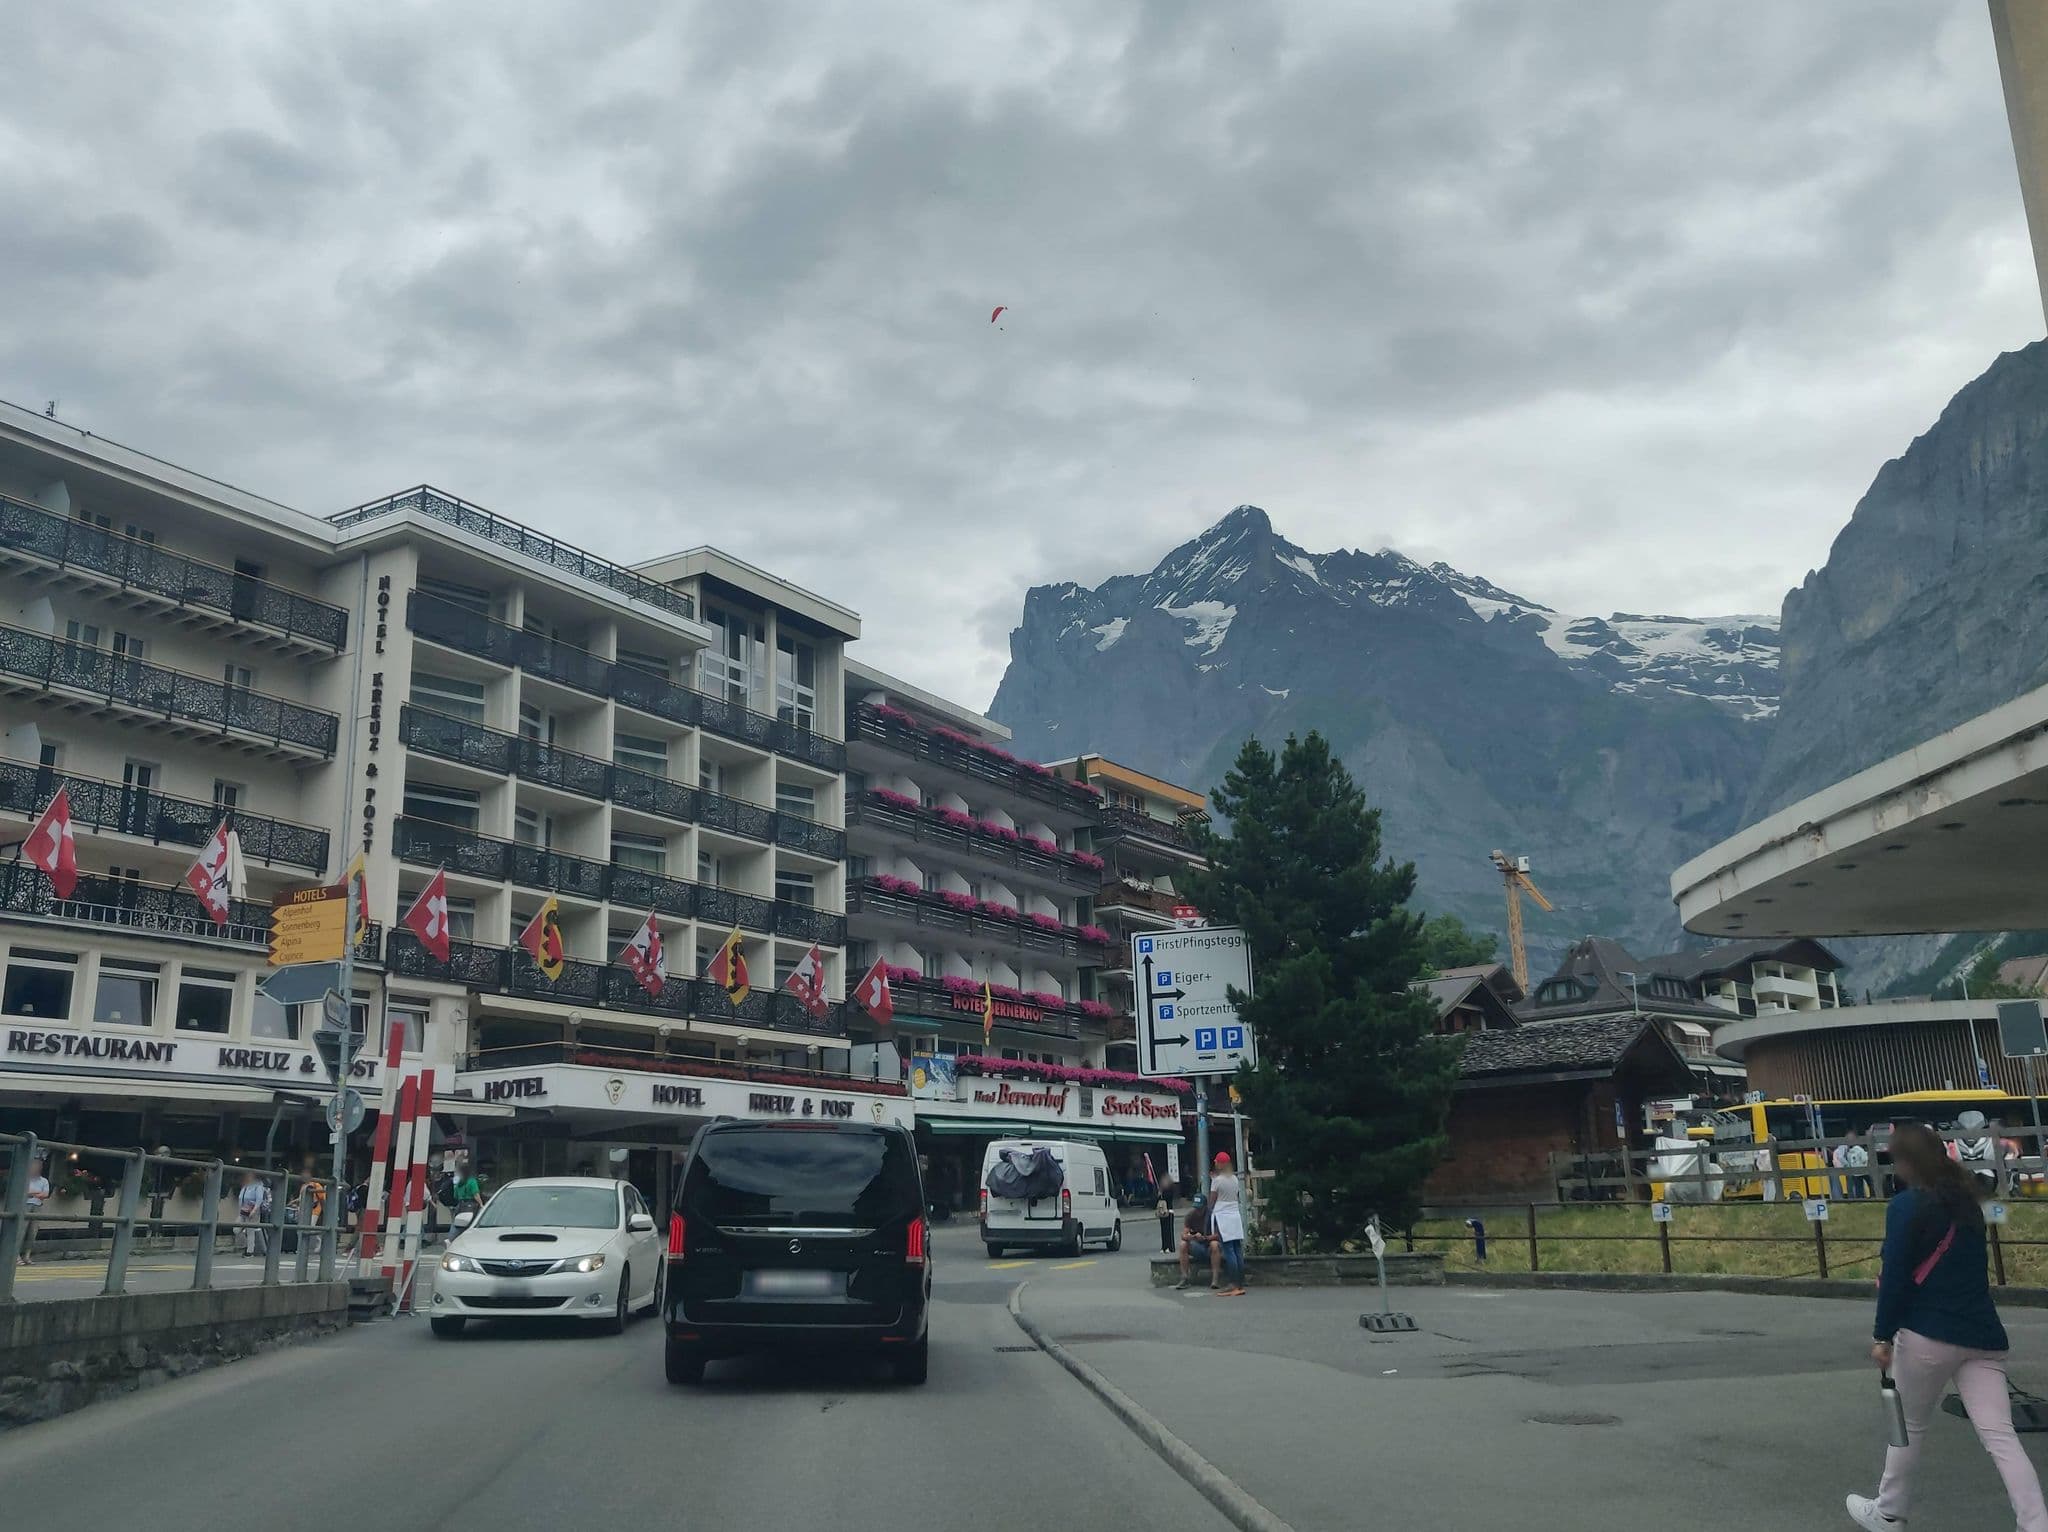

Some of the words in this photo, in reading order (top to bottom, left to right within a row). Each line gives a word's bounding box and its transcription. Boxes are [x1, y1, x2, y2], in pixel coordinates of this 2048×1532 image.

[374, 575, 390, 654] HOTEL
[368, 672, 384, 752] KREUZ
[365, 763, 378, 777] &
[362, 788, 376, 853] POST
[293, 887, 327, 903] HOTELS
[1156, 935, 1241, 950] First/Pfingstegg
[1175, 972, 1212, 985] Eiger+
[953, 994, 986, 1012] HOTEL
[1177, 1004, 1238, 1019] Sportzentru
[7, 1030, 177, 1063] RESTAURANT
[218, 1047, 291, 1071] KREUZ
[300, 1055, 316, 1073] &
[484, 1077, 548, 1101] HOTEL
[652, 1083, 706, 1108] HOTEL
[749, 1092, 795, 1114] KREUZ
[802, 1099, 814, 1115] &
[821, 1099, 855, 1118] POST
[974, 1090, 997, 1103] Hotel
[997, 1082, 1070, 1116] Bernerhof
